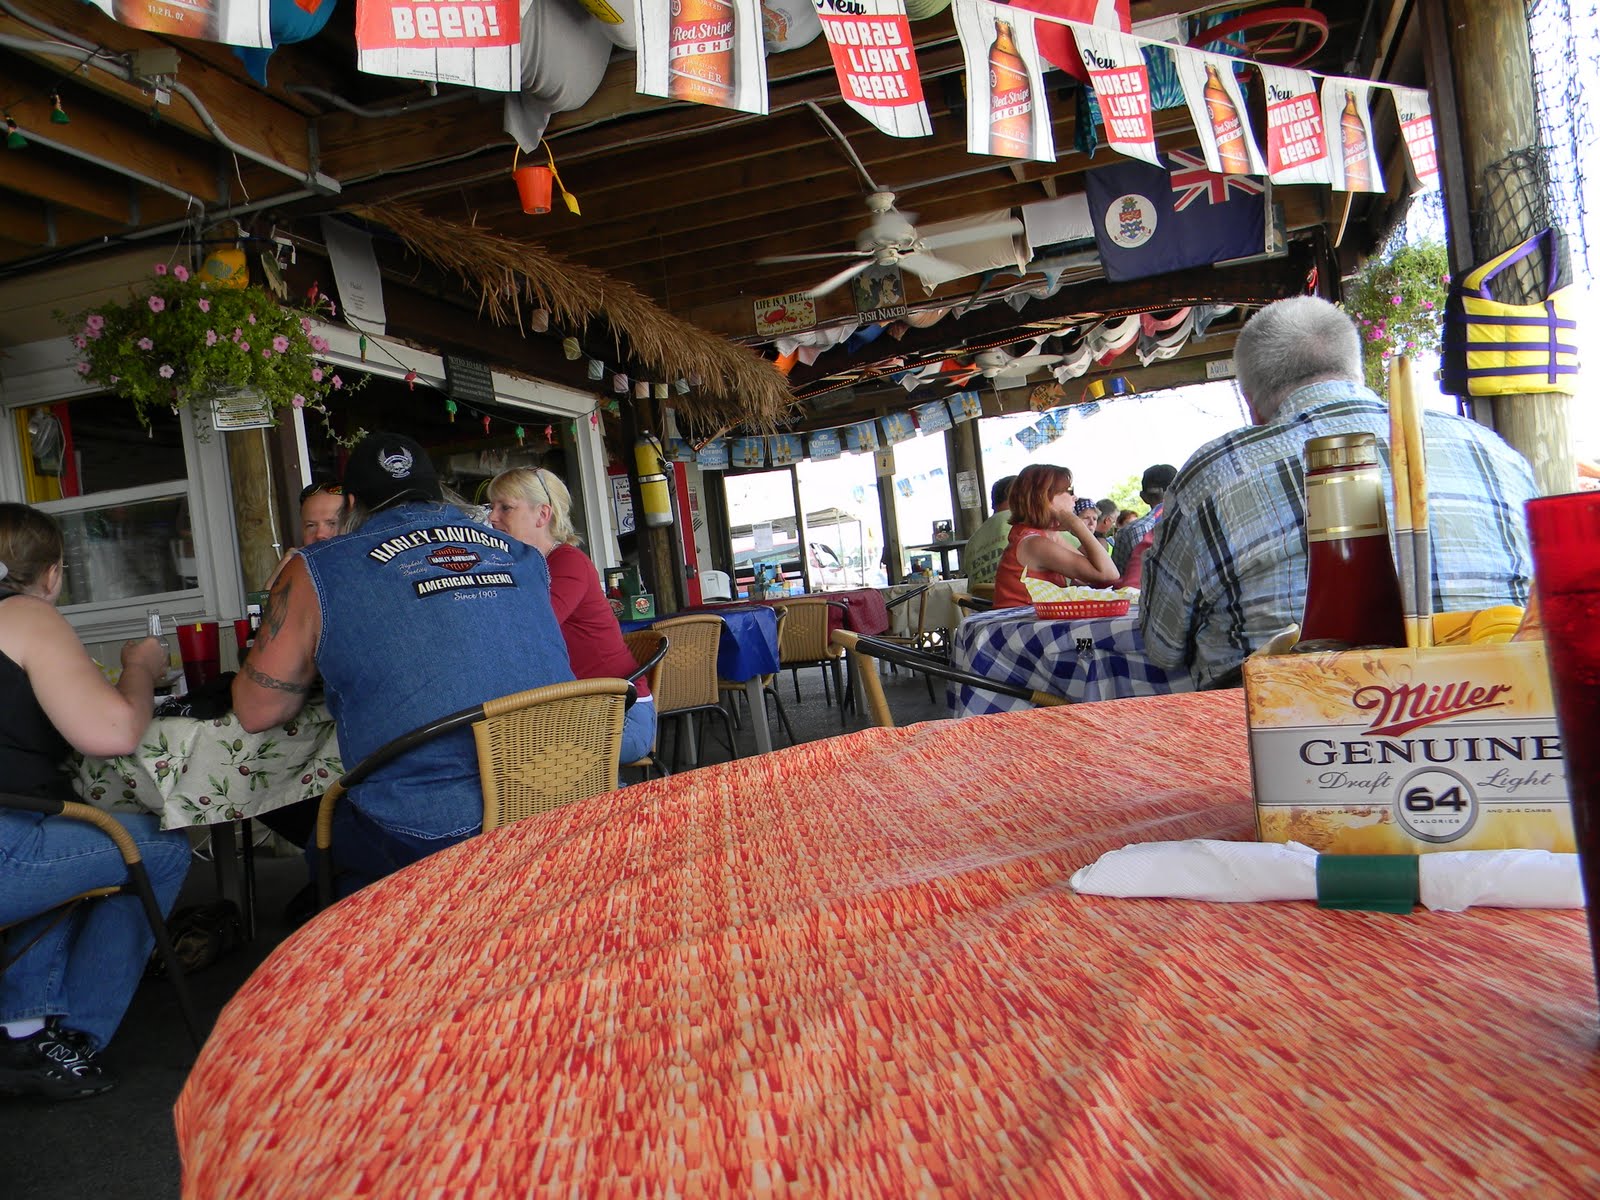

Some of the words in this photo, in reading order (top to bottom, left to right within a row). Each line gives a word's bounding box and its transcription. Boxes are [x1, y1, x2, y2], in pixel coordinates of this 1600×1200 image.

[673, 26, 697, 42] Red
[698, 21, 732, 39] Stripe
[676, 39, 731, 56] LIGHT
[1083, 49, 1117, 69] New
[683, 65, 722, 82] LAGER
[992, 95, 1008, 108] Red
[1008, 88, 1030, 104] Stripe
[1268, 84, 1294, 101] New
[994, 103, 1031, 120] LIGHT
[755, 299, 771, 310] LIFE
[772, 297, 780, 306] IS
[782, 296, 787, 305] A
[858, 311, 877, 324] FISH
[878, 306, 906, 320] NAKED
[812, 440, 835, 448] Corona
[369, 526, 509, 563] HARLEY-DAVIDSON
[418, 575, 475, 595] AMERICAN
[478, 573, 513, 585] LEGEND
[454, 592, 477, 601] Since
[478, 590, 498, 599] 1903
[1353, 681, 1513, 728] Miller
[1300, 735, 1563, 765] GENUINE
[1318, 771, 1394, 794] Draft
[1477, 768, 1554, 794] Light
[1405, 786, 1467, 812] 64
